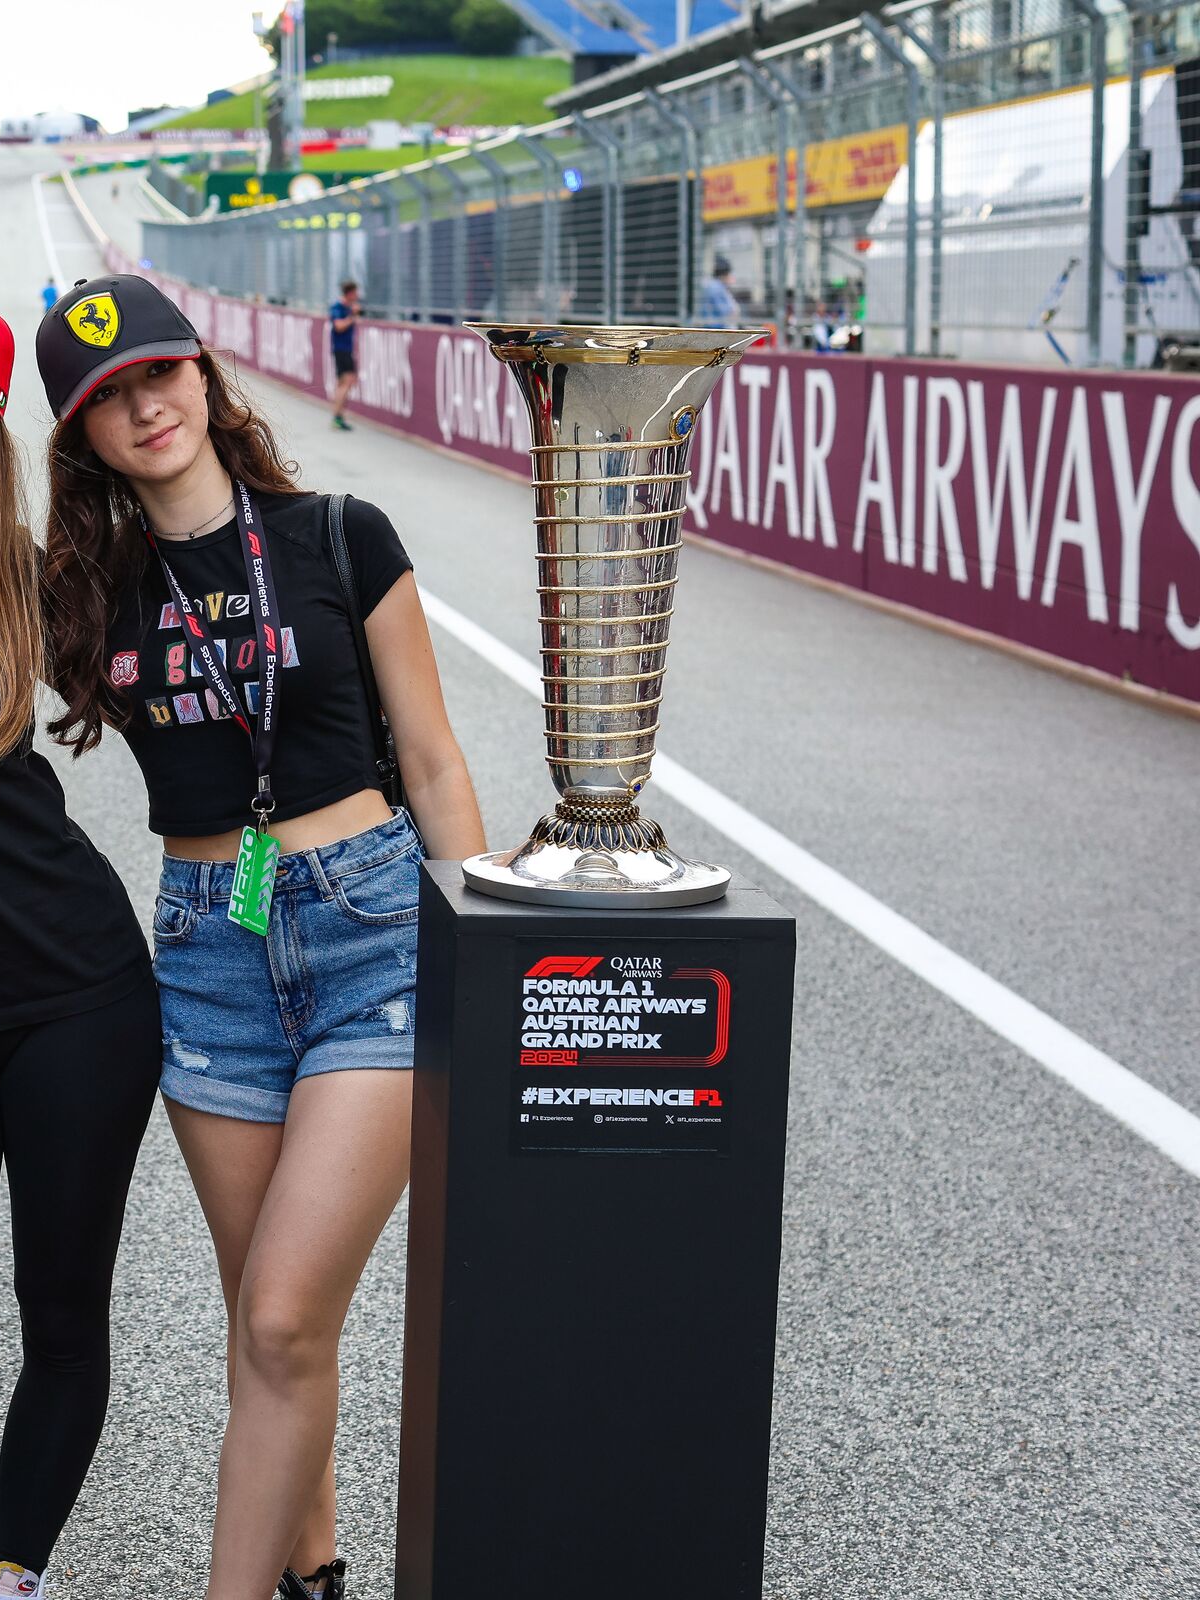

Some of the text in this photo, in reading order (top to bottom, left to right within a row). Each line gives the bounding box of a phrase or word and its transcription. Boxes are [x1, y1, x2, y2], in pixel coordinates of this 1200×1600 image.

[253, 558, 271, 617] Experiences
[200, 645, 237, 712] Experiences
[264, 655, 278, 731] Experiences
[229, 828, 257, 921] HERO
[610, 956, 662, 970] QATAR
[622, 970, 663, 979] AIRWAYS
[523, 979, 654, 996] FORMULA 1
[522, 997, 707, 1014] QATAR AIRWAYS
[521, 1015, 640, 1031] AUSTRIAN
[521, 1032, 662, 1049] GRAND PRIX
[520, 1050, 578, 1066] 2024
[521, 1087, 723, 1107] #EXPERIENCEF1
